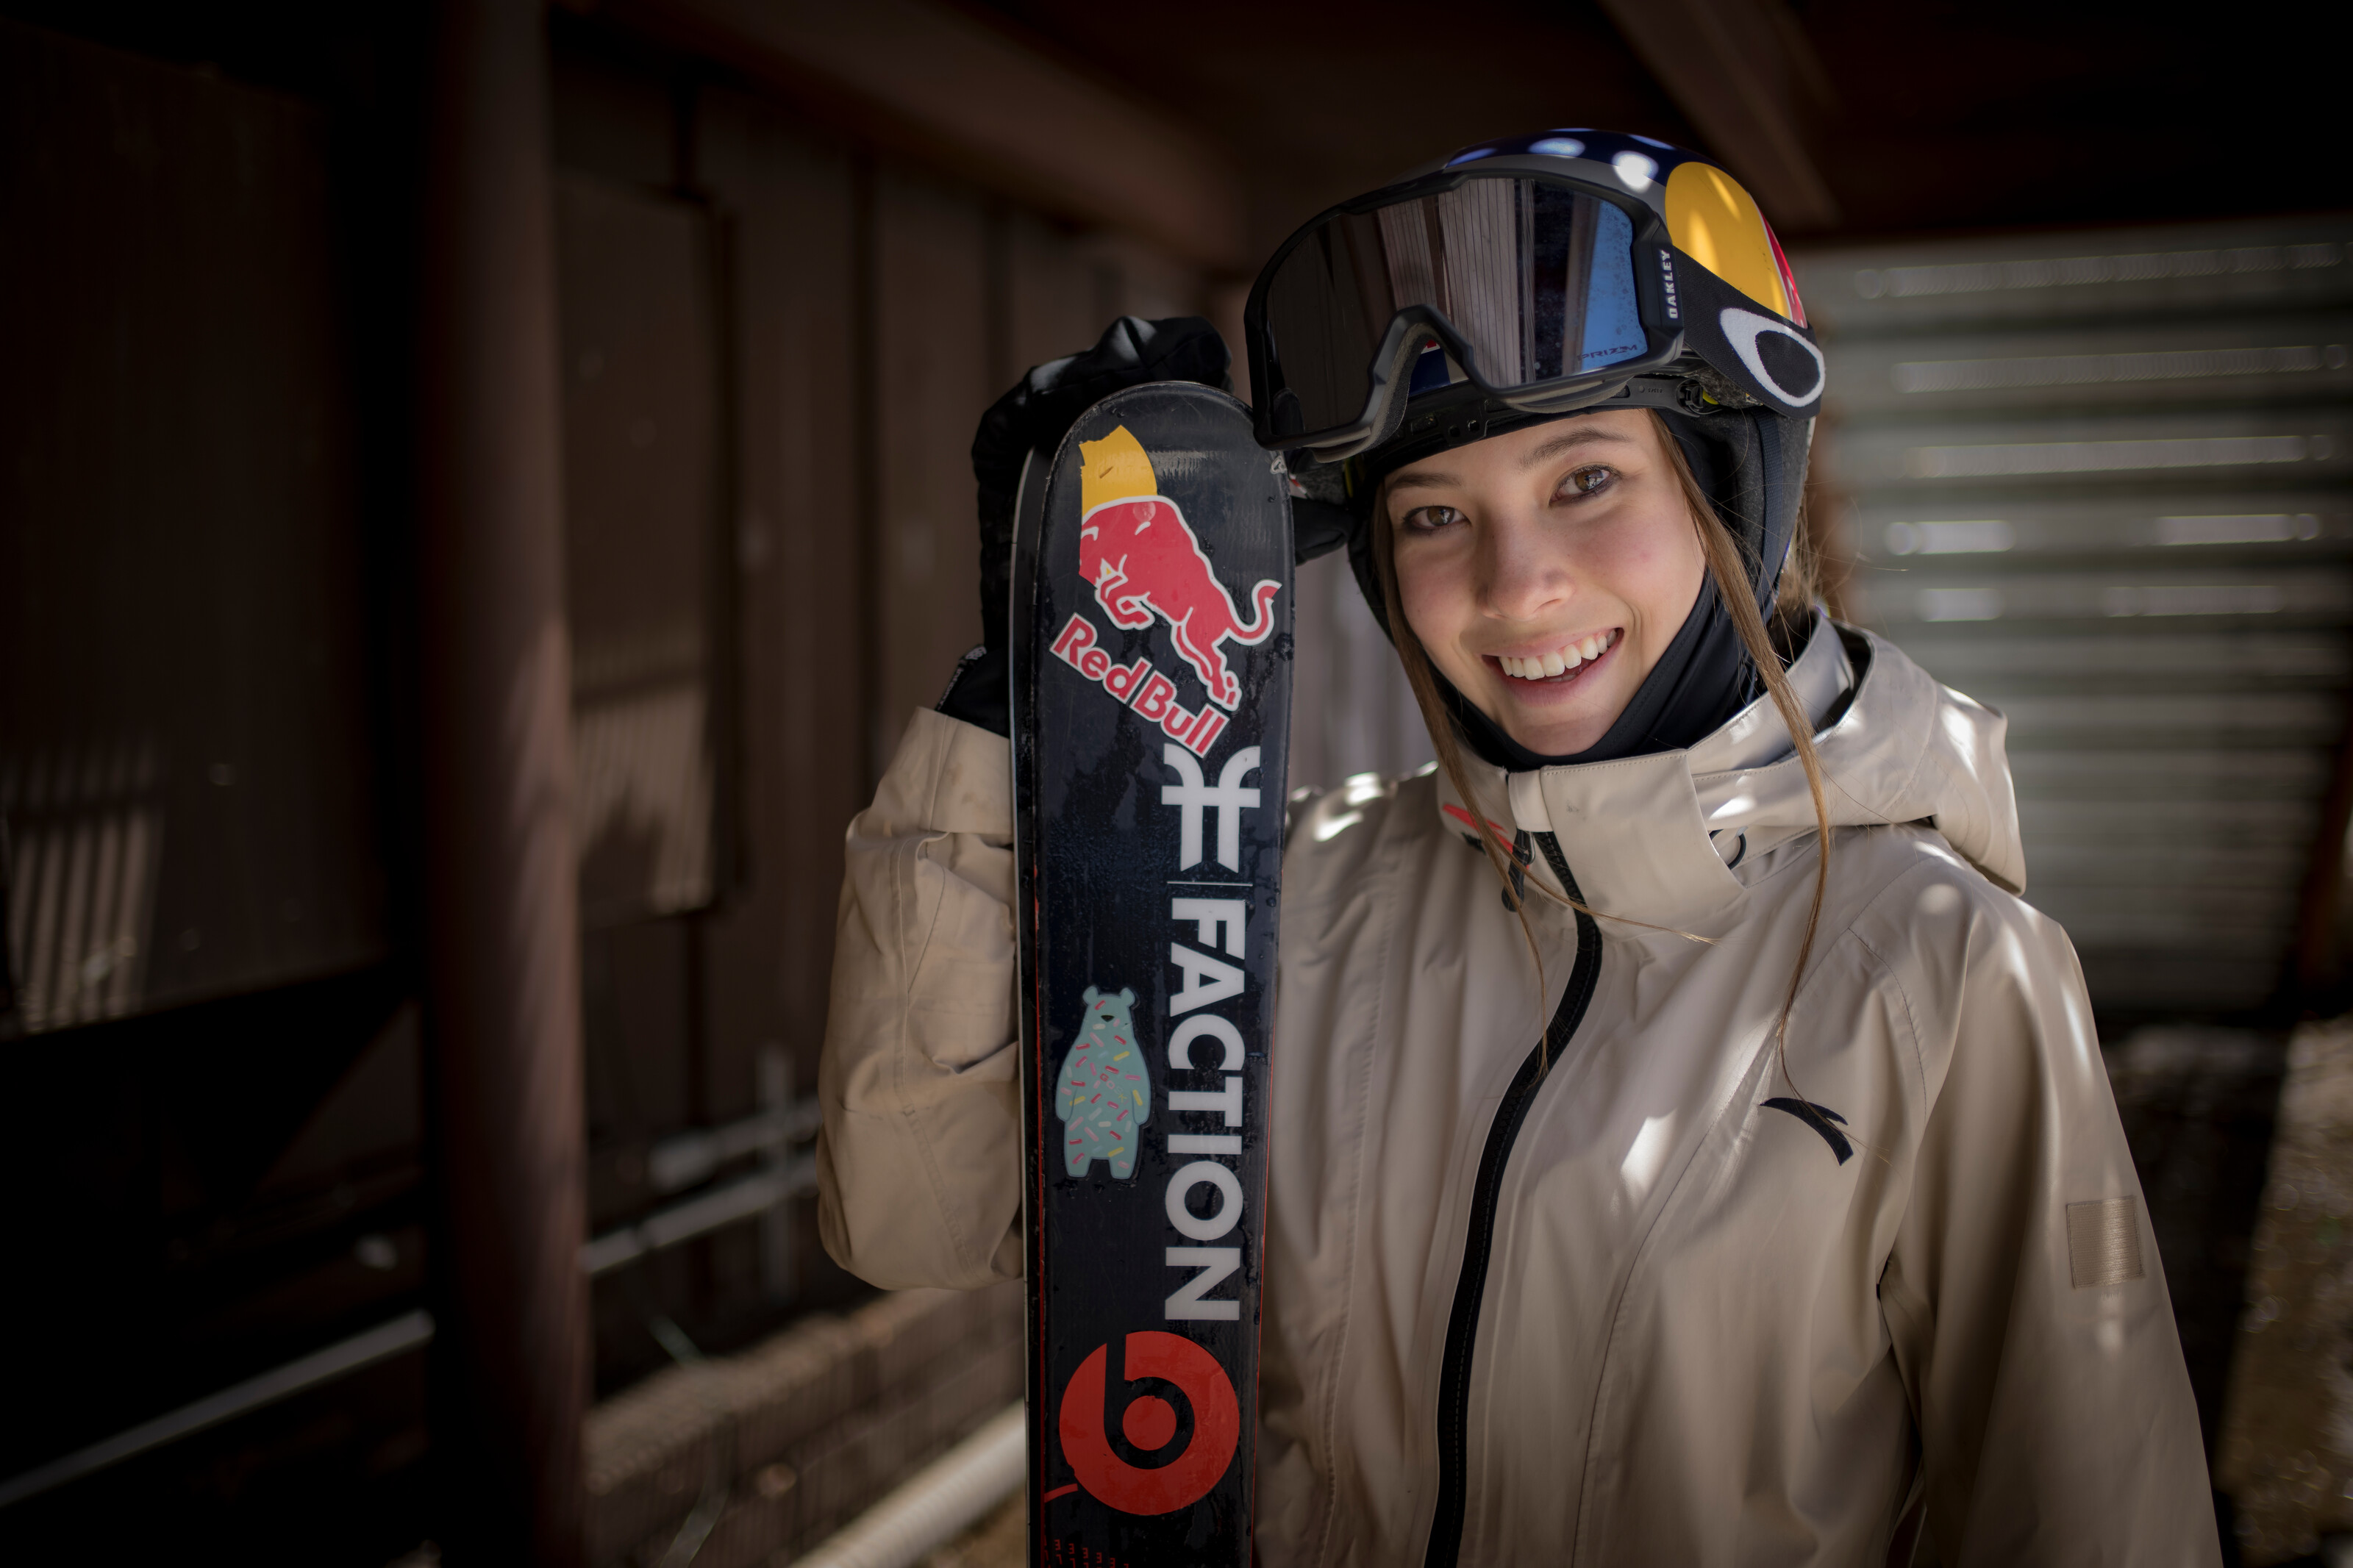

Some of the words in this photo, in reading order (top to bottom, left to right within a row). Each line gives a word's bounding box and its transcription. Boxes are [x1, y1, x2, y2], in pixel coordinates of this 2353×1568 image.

[1660, 249, 1679, 319] OAKLEY
[1577, 344, 1638, 361] PRIZM
[1049, 612, 1152, 704] Red
[1129, 670, 1229, 758] Bull
[1165, 898, 1246, 1321] FACTION
